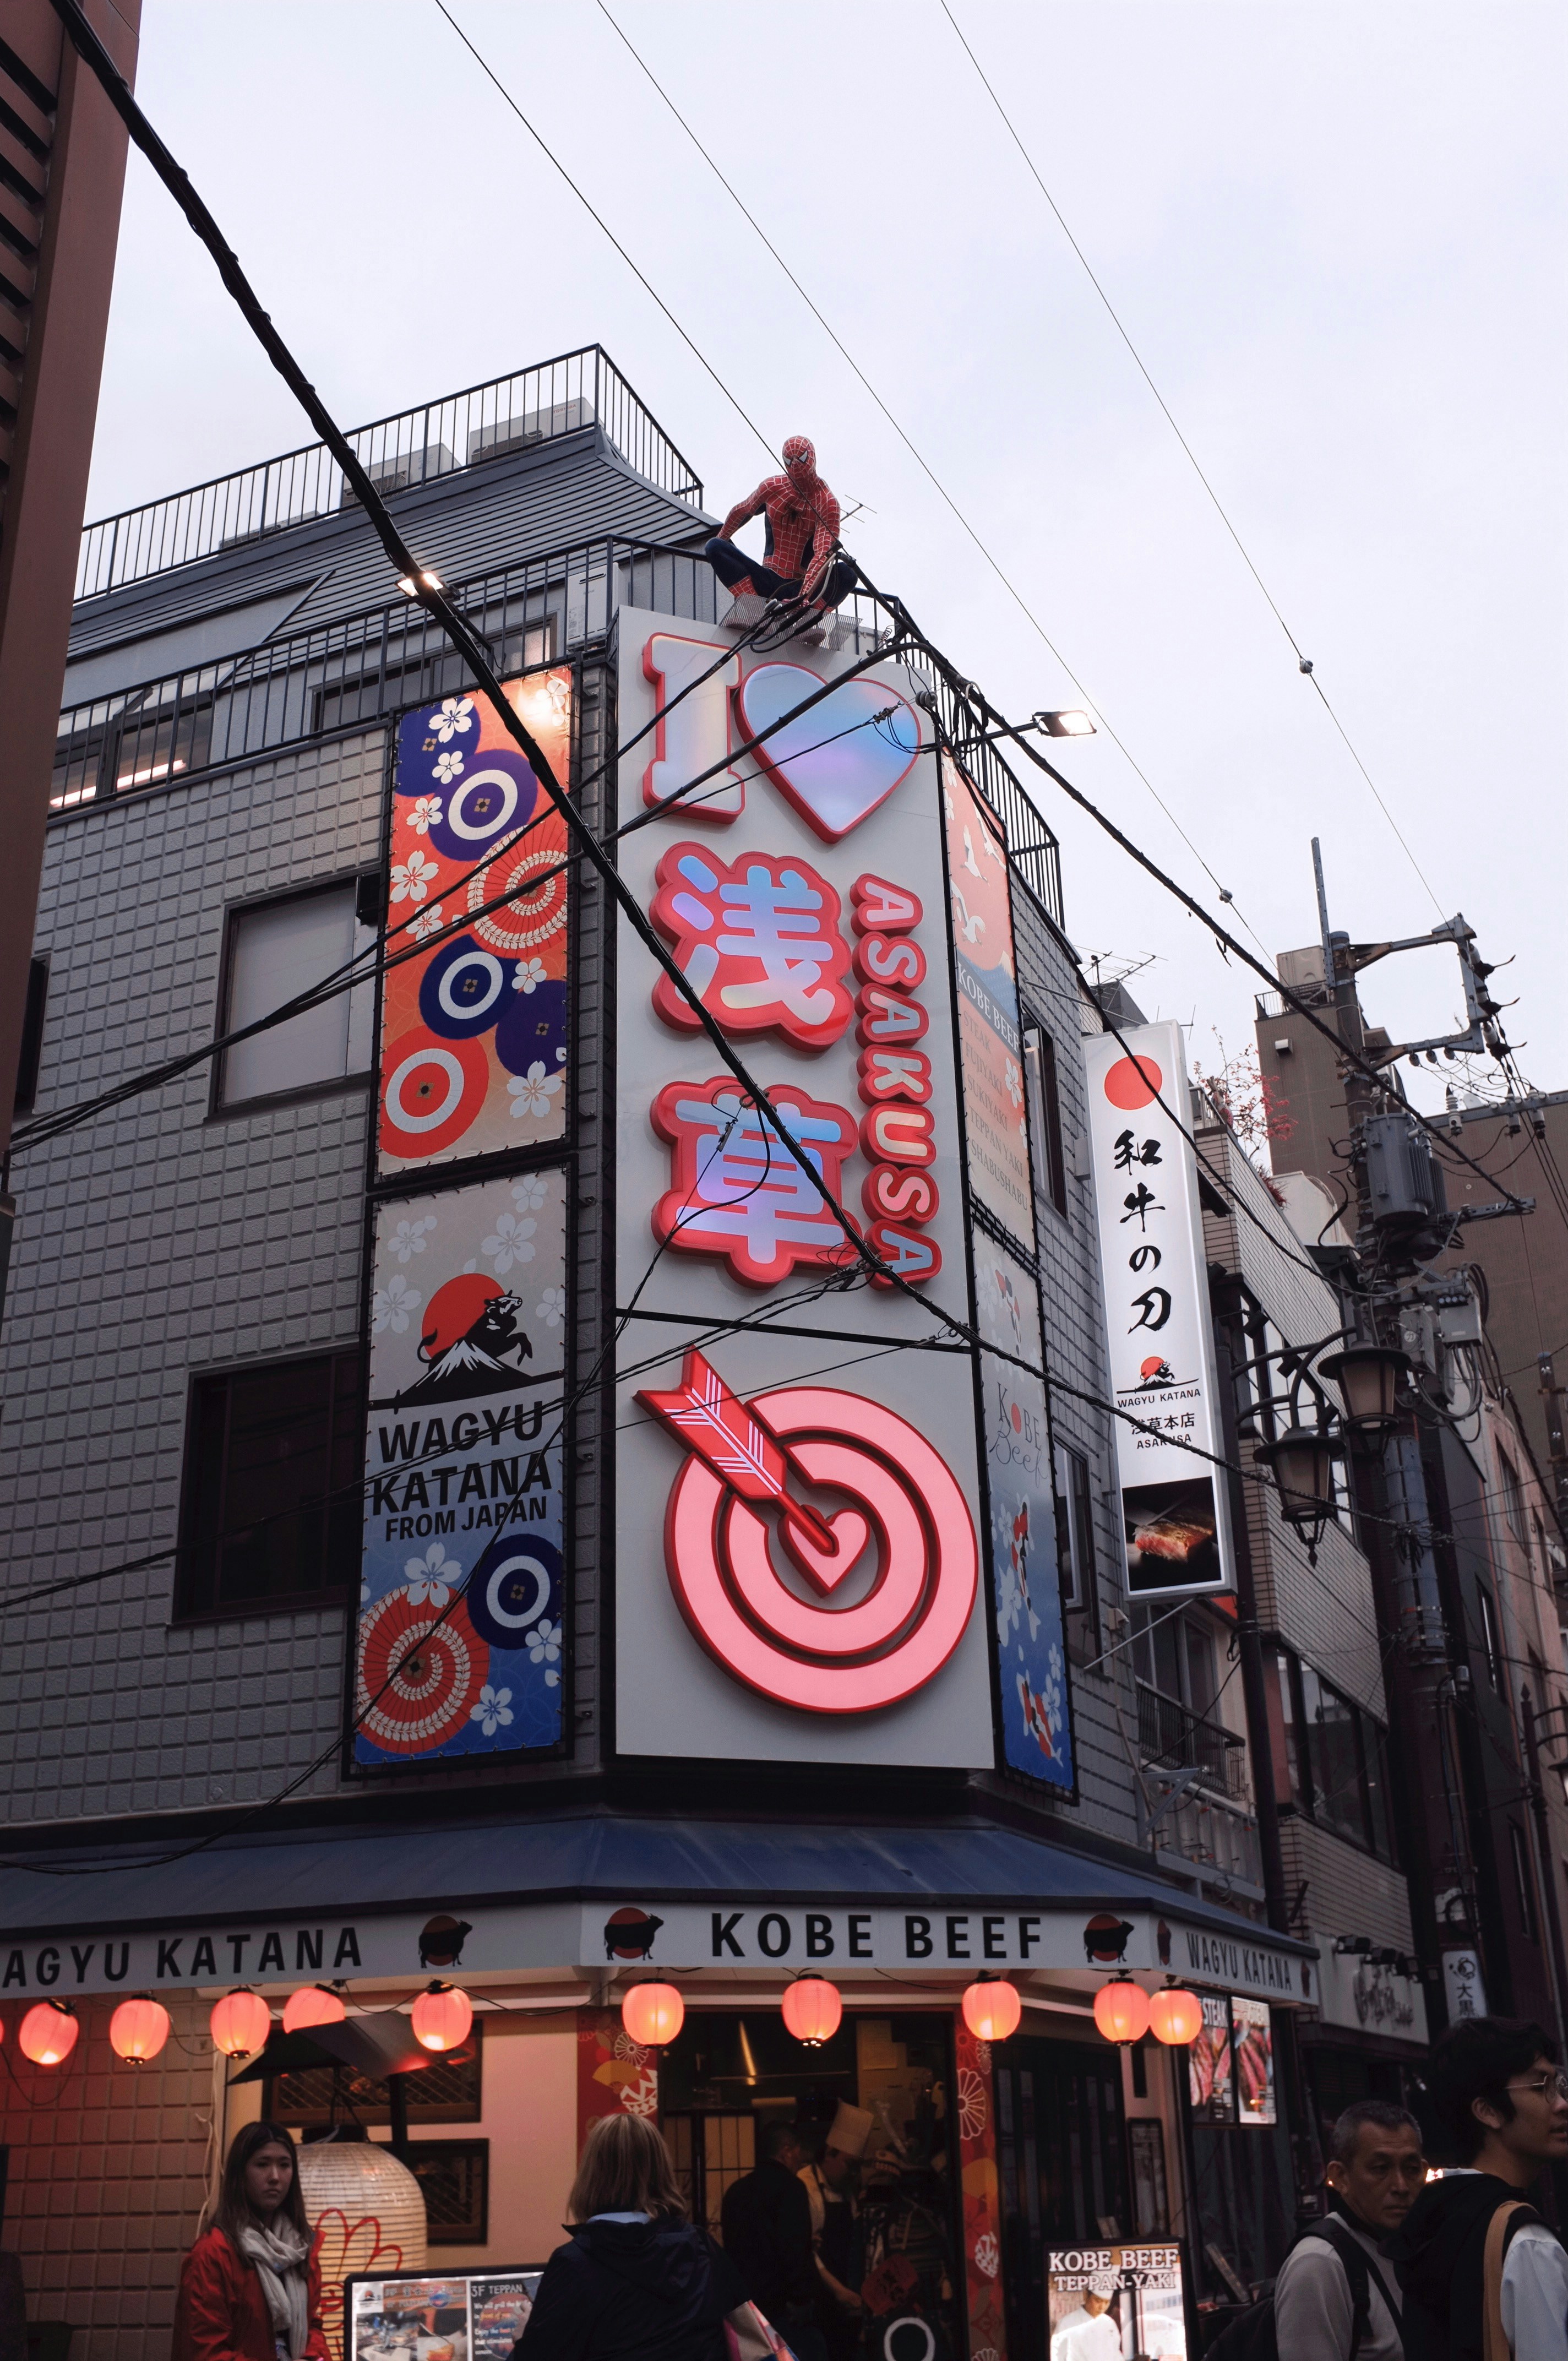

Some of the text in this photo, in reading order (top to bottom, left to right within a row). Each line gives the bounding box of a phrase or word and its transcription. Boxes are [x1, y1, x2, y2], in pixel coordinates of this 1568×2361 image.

[643, 633, 745, 822] I
[957, 961, 1020, 1053] KOBE BEEF
[964, 1010, 990, 1053] STEAK
[653, 842, 857, 1286] 浅草
[852, 874, 941, 1288] ASAKUSA
[967, 1074, 1008, 1132] SUKIYAKI
[969, 1105, 1023, 1178] TEPPAN YAKI
[971, 1139, 1027, 1211] SHABUSHABU
[1114, 1129, 1172, 1335] 和牛の刀
[1118, 1389, 1201, 1408] WAGYU KATANA
[379, 1401, 543, 1464] WAGYU
[1137, 1434, 1191, 1449] ASAKSA
[373, 1452, 552, 1516] KATANA
[386, 1496, 547, 1542] FROM JAPAN
[156, 1927, 362, 1978] KATANA
[712, 1912, 1041, 1959] KOBE BEEF
[1186, 1932, 1292, 1991] WAGYU KATANA
[1048, 2248, 1179, 2272] KOBE BEEF
[1053, 2272, 1176, 2292] TEPPAN-YAKI
[471, 2285, 485, 2298] 3F
[488, 2283, 523, 2295] TEPPAN
